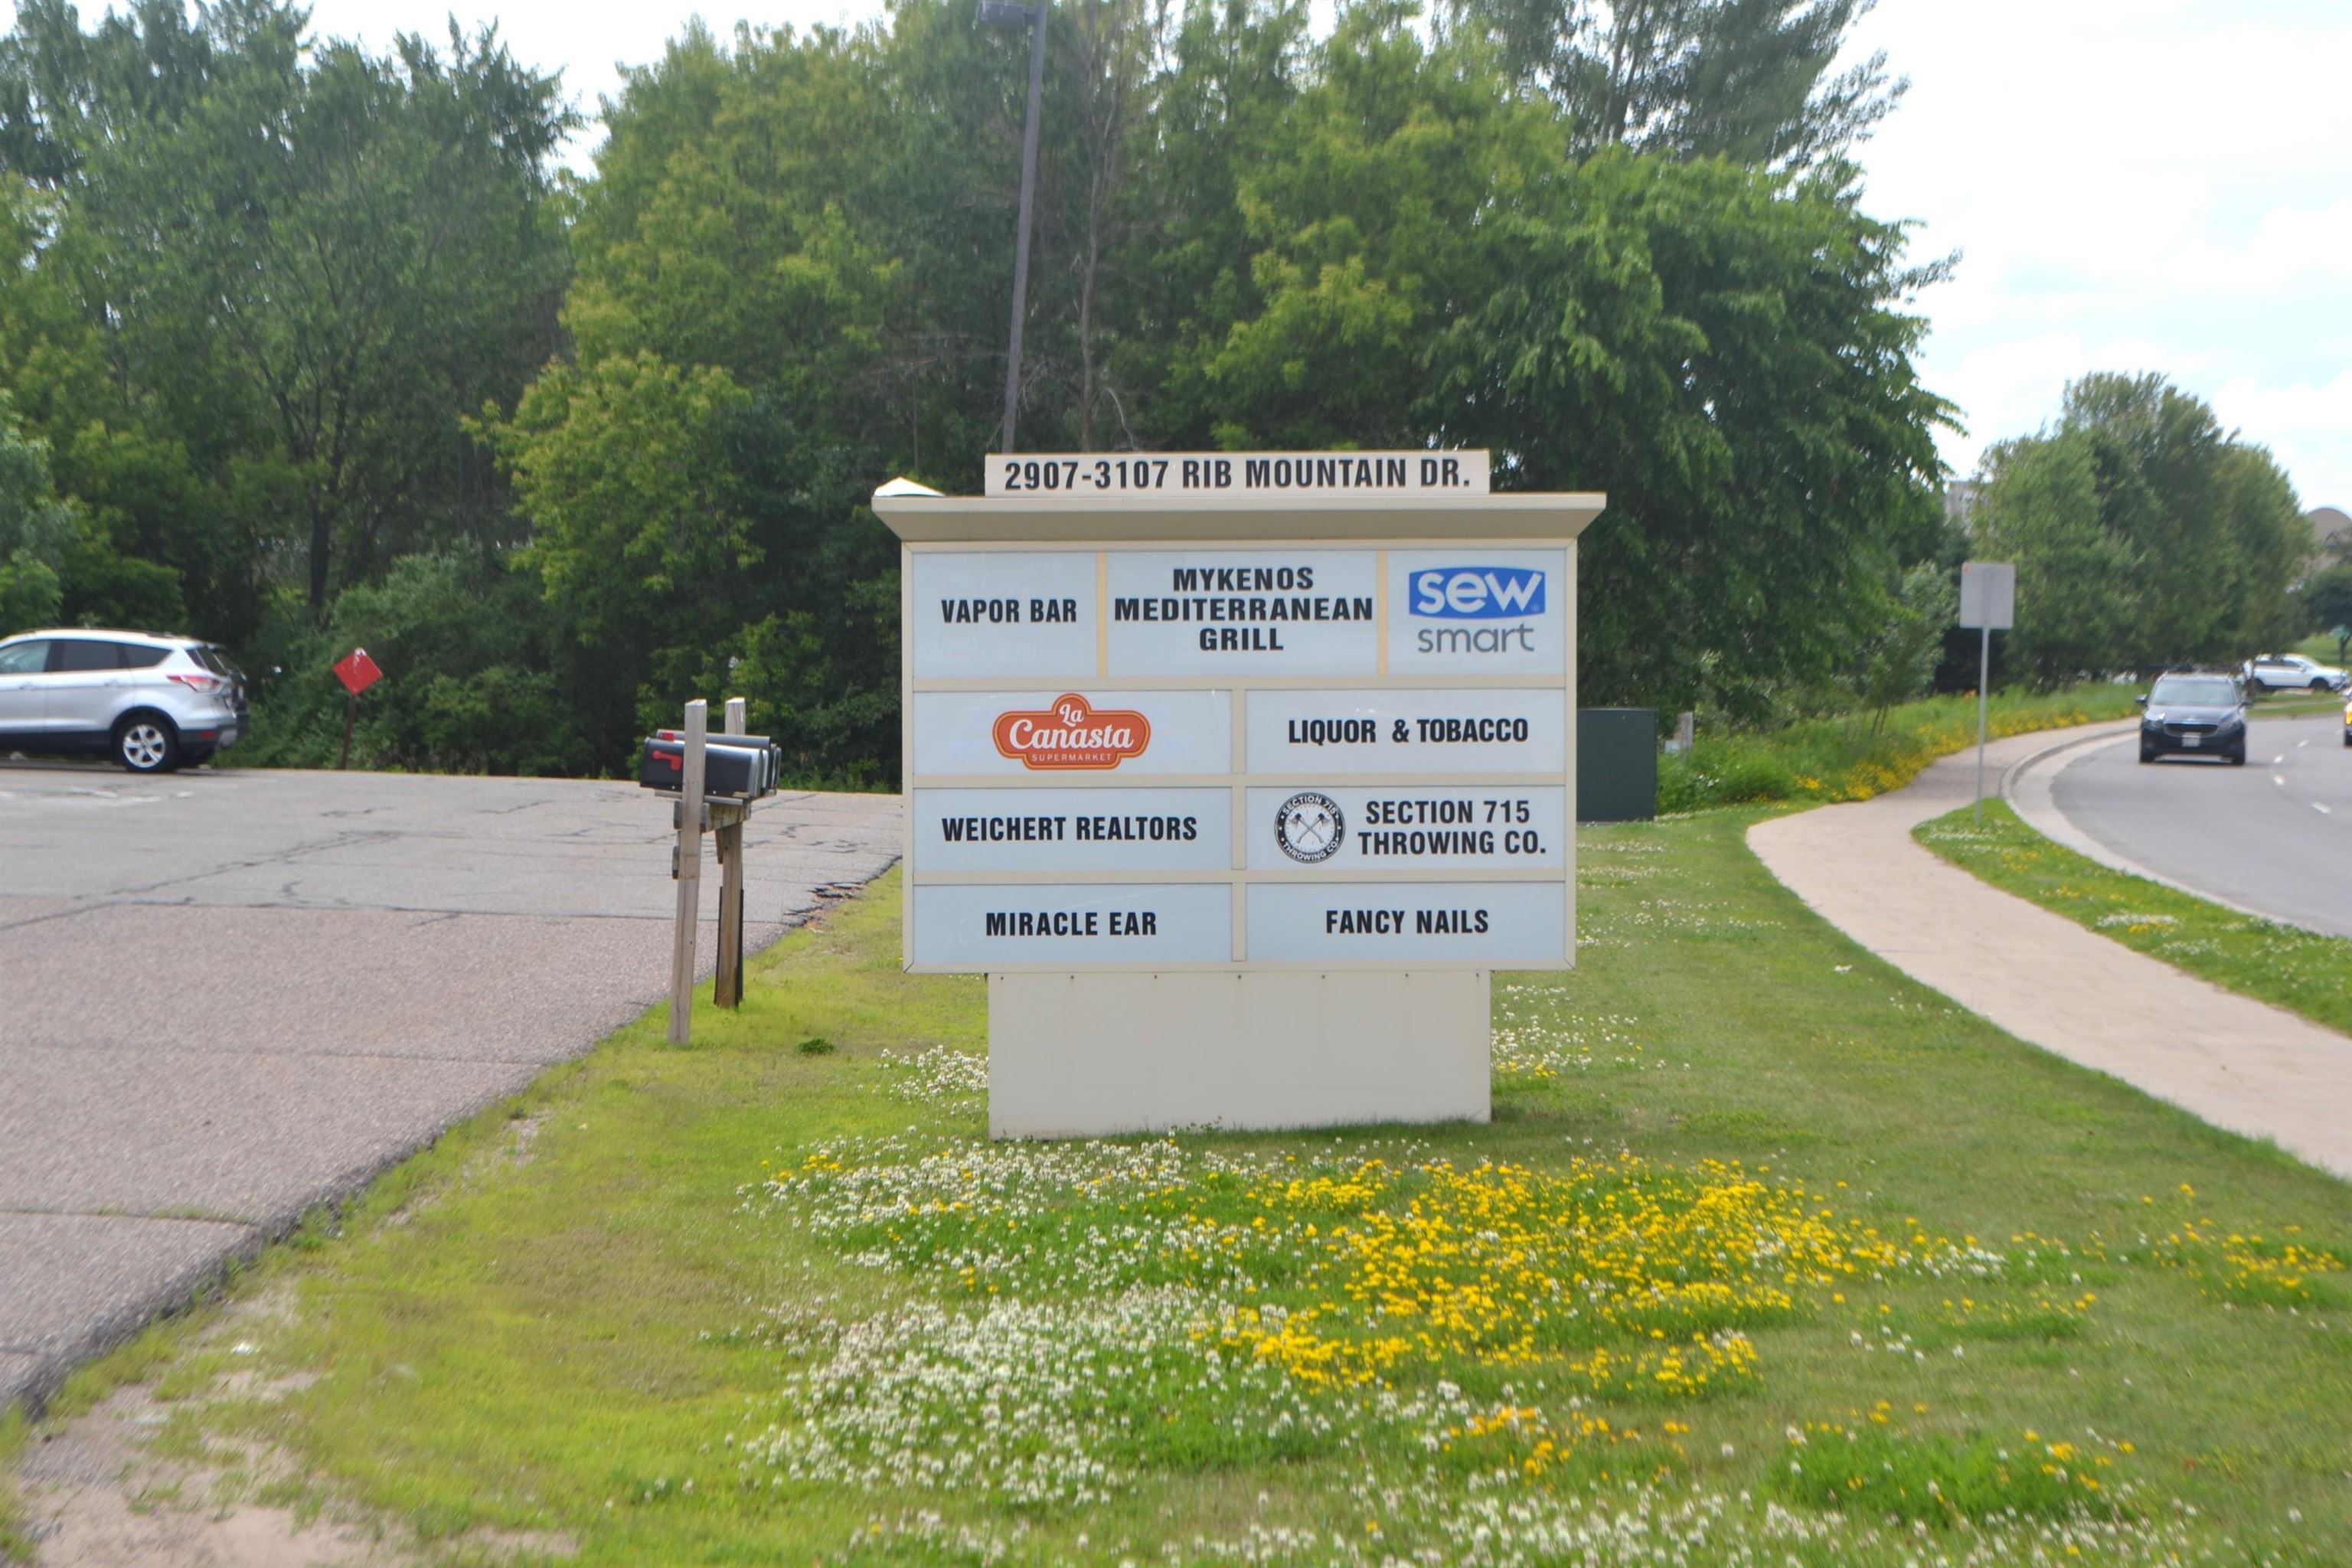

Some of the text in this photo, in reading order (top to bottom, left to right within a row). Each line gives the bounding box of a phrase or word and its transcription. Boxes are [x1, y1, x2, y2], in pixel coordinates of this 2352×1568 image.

[1004, 458, 1470, 490] 2907-3107 RIB MOUNTAIN DR.
[1173, 567, 1315, 591] MYKENOS
[1417, 572, 1543, 614] sew
[941, 599, 1077, 623] VAPOR BAR
[1115, 597, 1373, 621] MEDITERRANEAN
[1199, 628, 1284, 651] GRILL
[1417, 622, 1535, 653] smart
[1060, 704, 1084, 727] La
[1009, 718, 1135, 750] Canasta
[1289, 718, 1529, 746] LIQUOR & TOBACCO
[1031, 753, 1112, 762] SUPERMARKET
[1282, 796, 1338, 815] SECTION 715
[1366, 800, 1530, 825] SECTION 715
[941, 816, 1197, 841] WEICHERT REALTORS
[1283, 842, 1327, 861] THROWING
[1357, 830, 1547, 855] THROWING CO.
[985, 912, 1157, 936] MIRACLE EAR
[1326, 910, 1489, 934] FANCY NAILS
